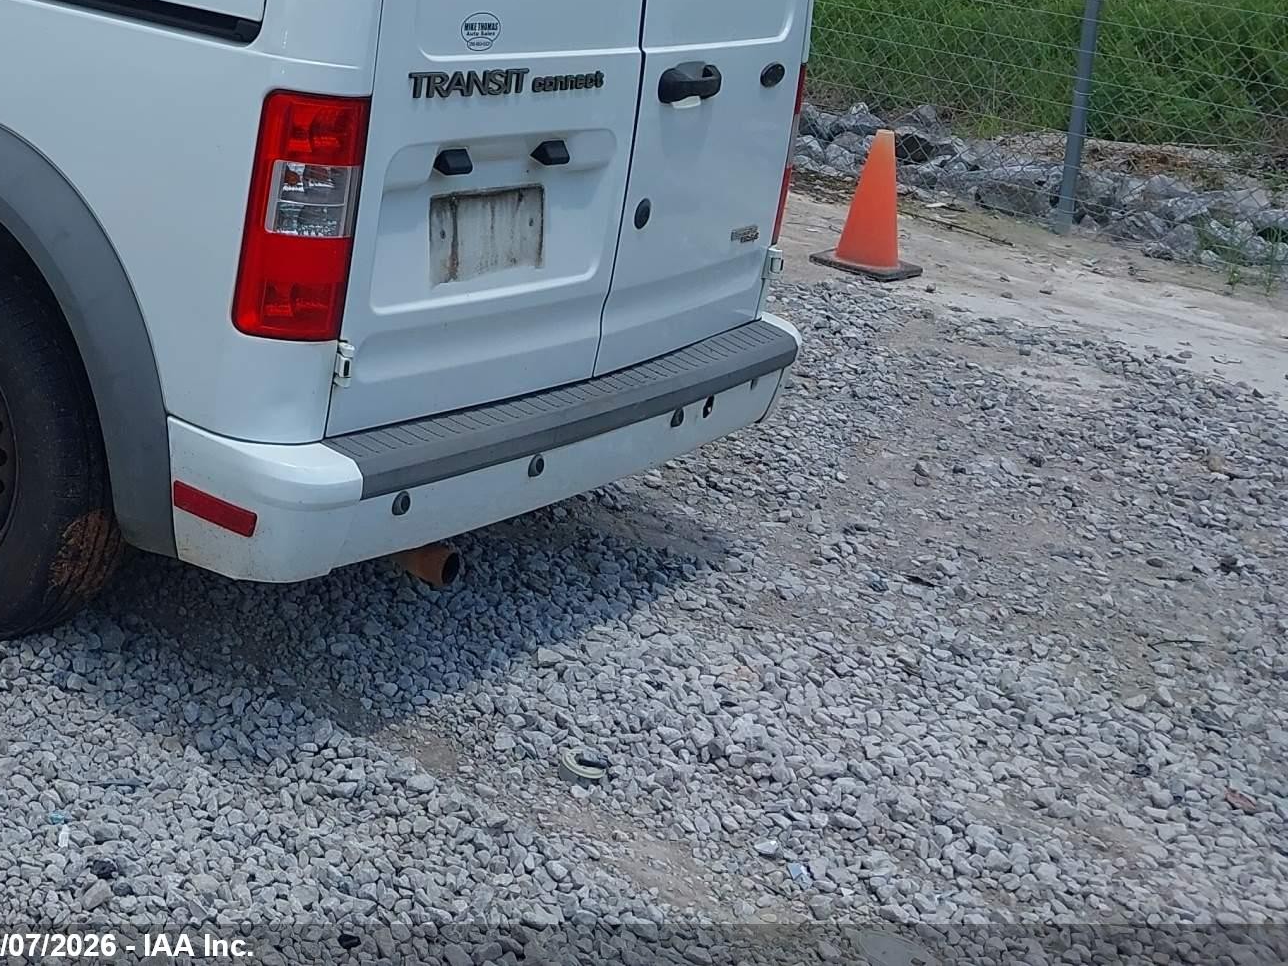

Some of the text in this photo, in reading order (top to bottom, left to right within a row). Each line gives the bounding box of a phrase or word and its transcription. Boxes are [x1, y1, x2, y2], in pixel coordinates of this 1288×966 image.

[464, 22, 498, 31] MIKE THOMAS
[408, 68, 604, 98] TRANSIT connect
